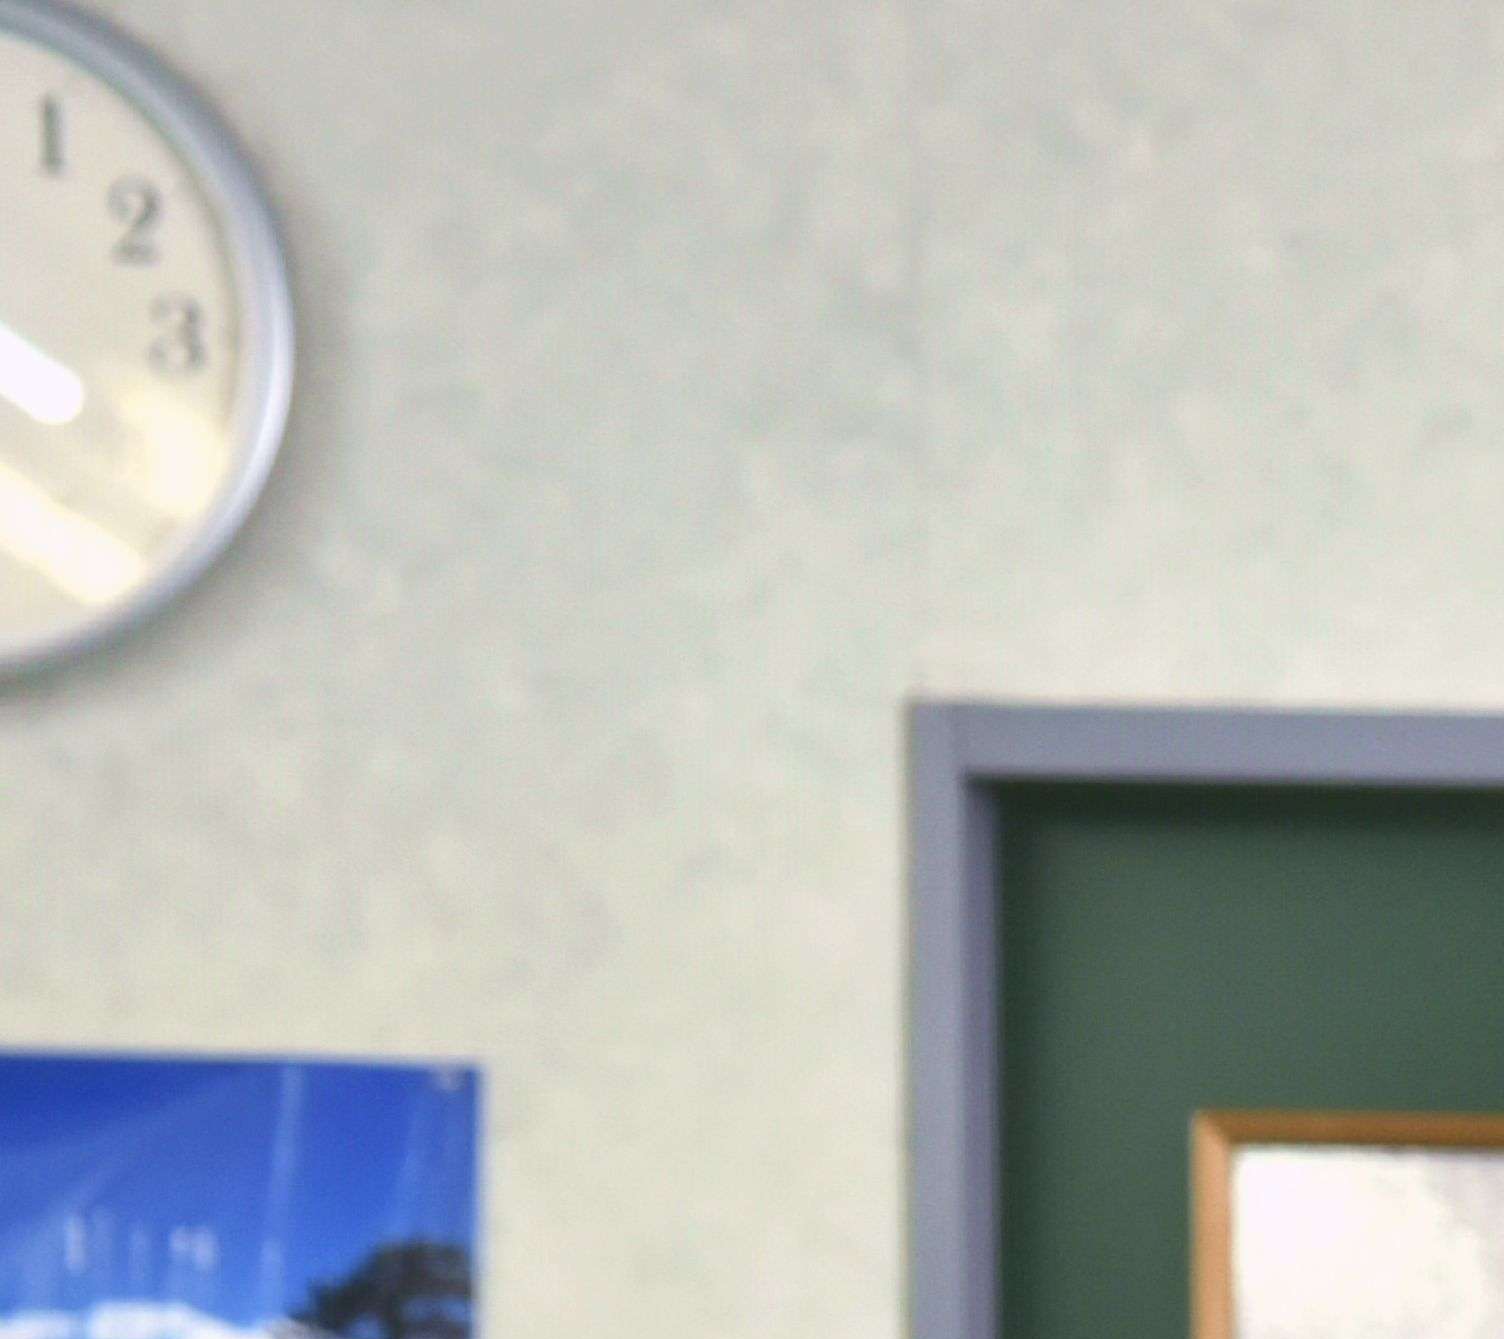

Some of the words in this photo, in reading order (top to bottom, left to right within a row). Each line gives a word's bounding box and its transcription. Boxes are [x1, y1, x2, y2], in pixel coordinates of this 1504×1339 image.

[40, 94, 64, 176] 1
[106, 174, 162, 266] 2
[148, 293, 207, 378] 3
